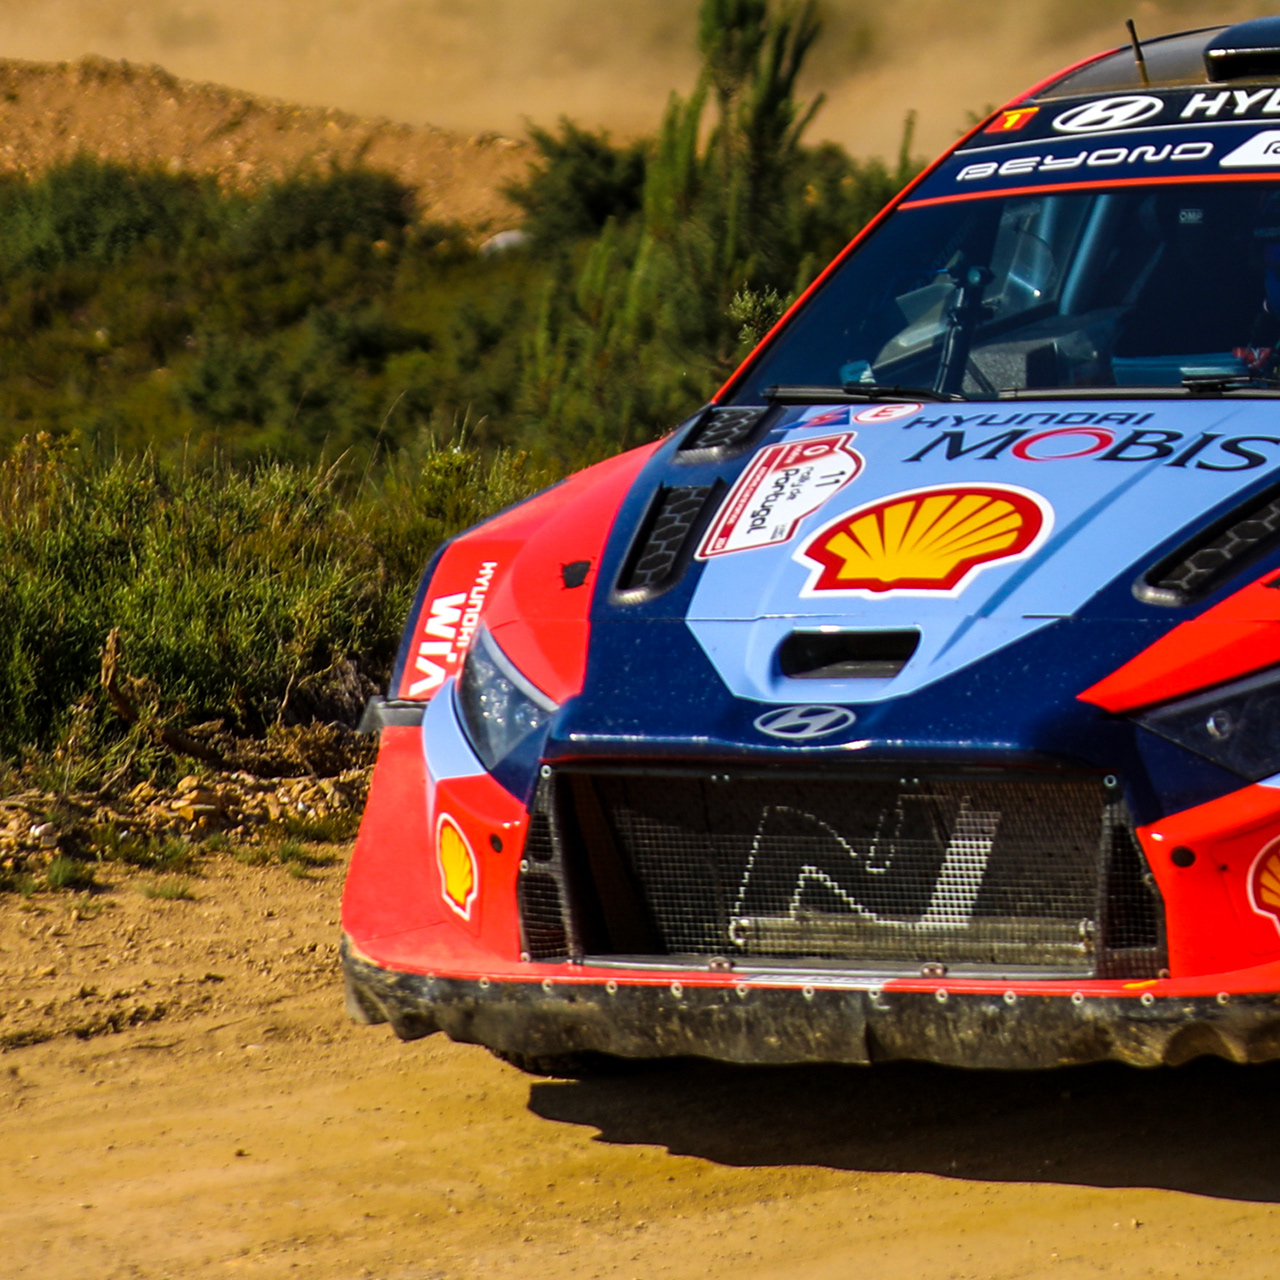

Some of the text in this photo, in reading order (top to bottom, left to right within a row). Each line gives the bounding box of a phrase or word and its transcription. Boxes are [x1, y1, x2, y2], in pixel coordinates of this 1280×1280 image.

[956, 142, 1214, 181] BEYOND
[903, 412, 1154, 429] HYUNDAI
[746, 468, 800, 535] Portugal
[815, 470, 847, 488] 11
[456, 562, 498, 648] HYUNDAI
[408, 592, 467, 697] WIA
